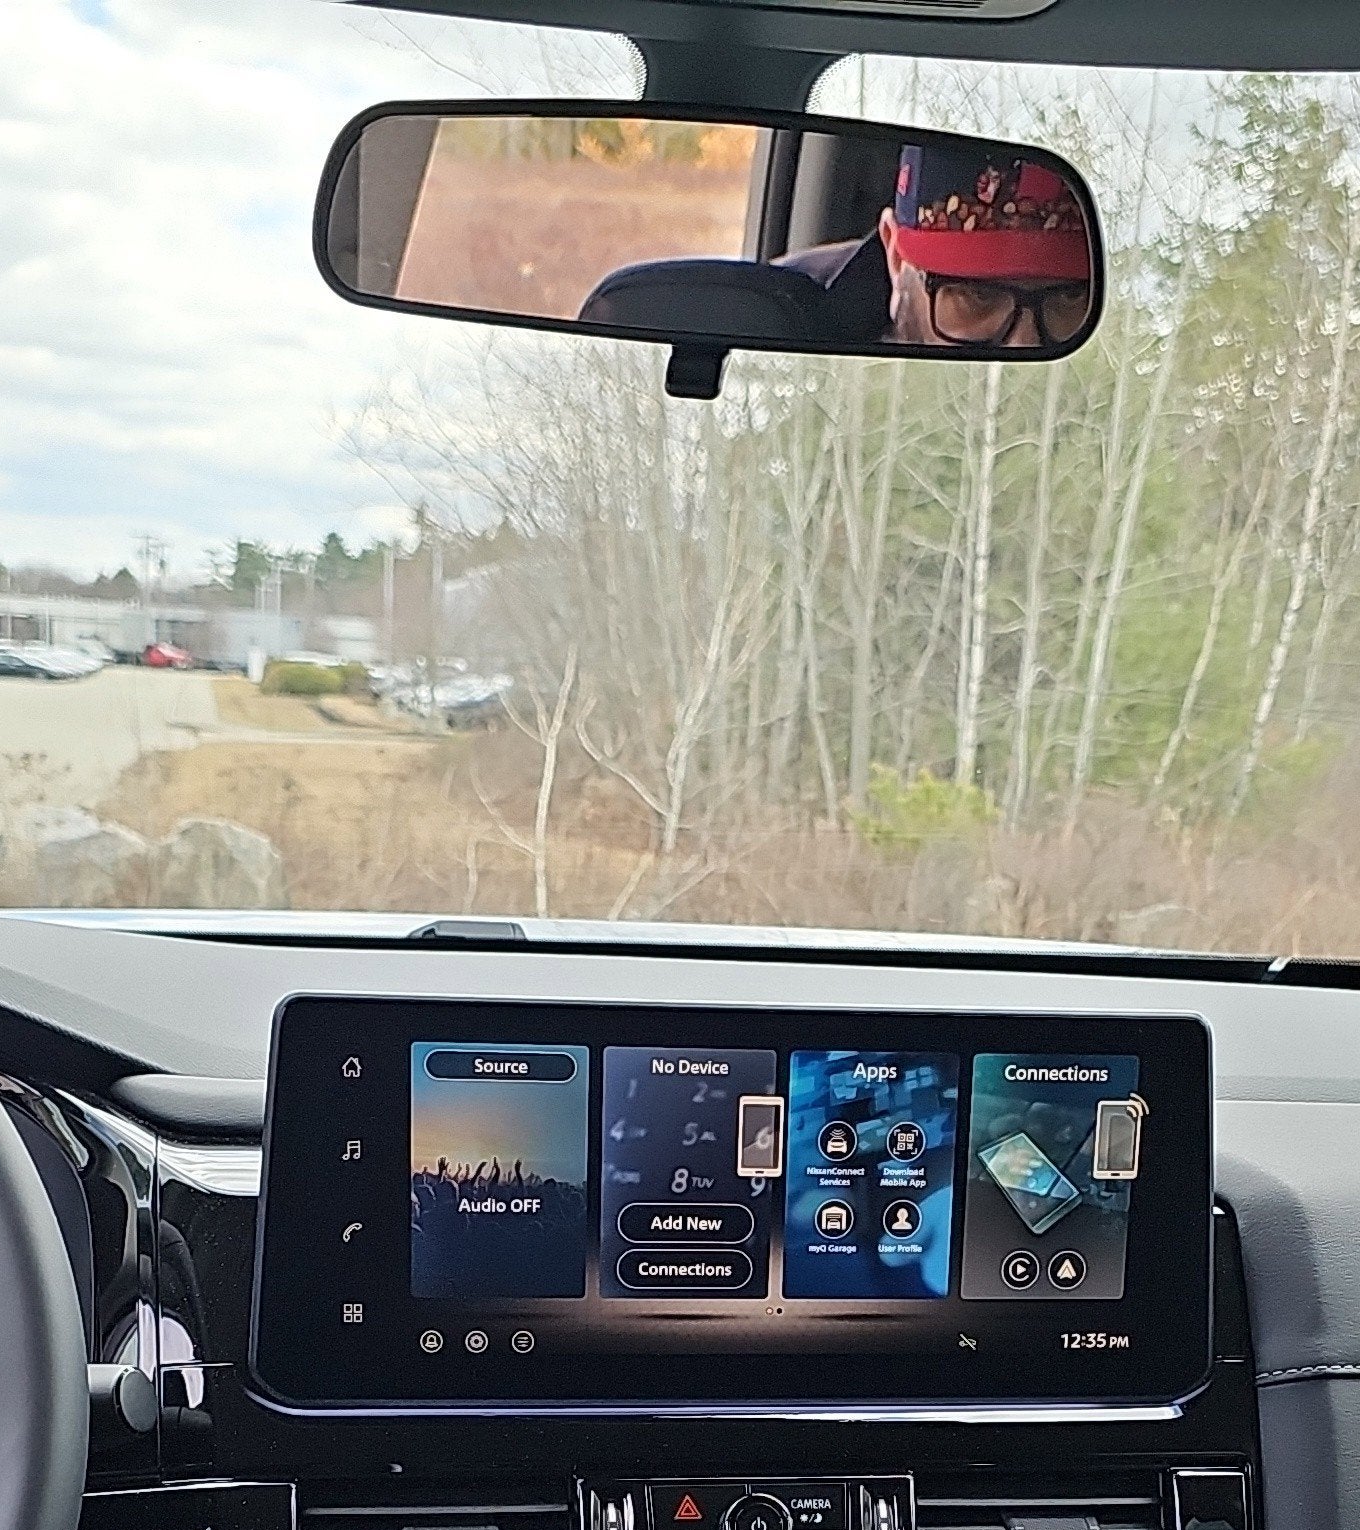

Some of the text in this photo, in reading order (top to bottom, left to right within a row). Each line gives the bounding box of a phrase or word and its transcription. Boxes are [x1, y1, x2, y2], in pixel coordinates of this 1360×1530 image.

[474, 1059, 529, 1074] Source
[652, 1060, 729, 1075] No Device
[853, 1063, 897, 1079] Apps
[1004, 1064, 1108, 1082] Connections
[883, 1167, 925, 1176] Download
[671, 1168, 689, 1194] 8
[819, 1178, 851, 1186] Services
[880, 1179, 927, 1188] Mobile App
[458, 1199, 541, 1214] Audio OFF
[651, 1216, 722, 1231] Add New
[828, 1245, 857, 1254] Garage
[878, 1244, 923, 1253] User Profile
[638, 1262, 733, 1278] Connections
[1060, 1333, 1130, 1349] 12:35 PM
[790, 1498, 832, 1510] CAMERA
